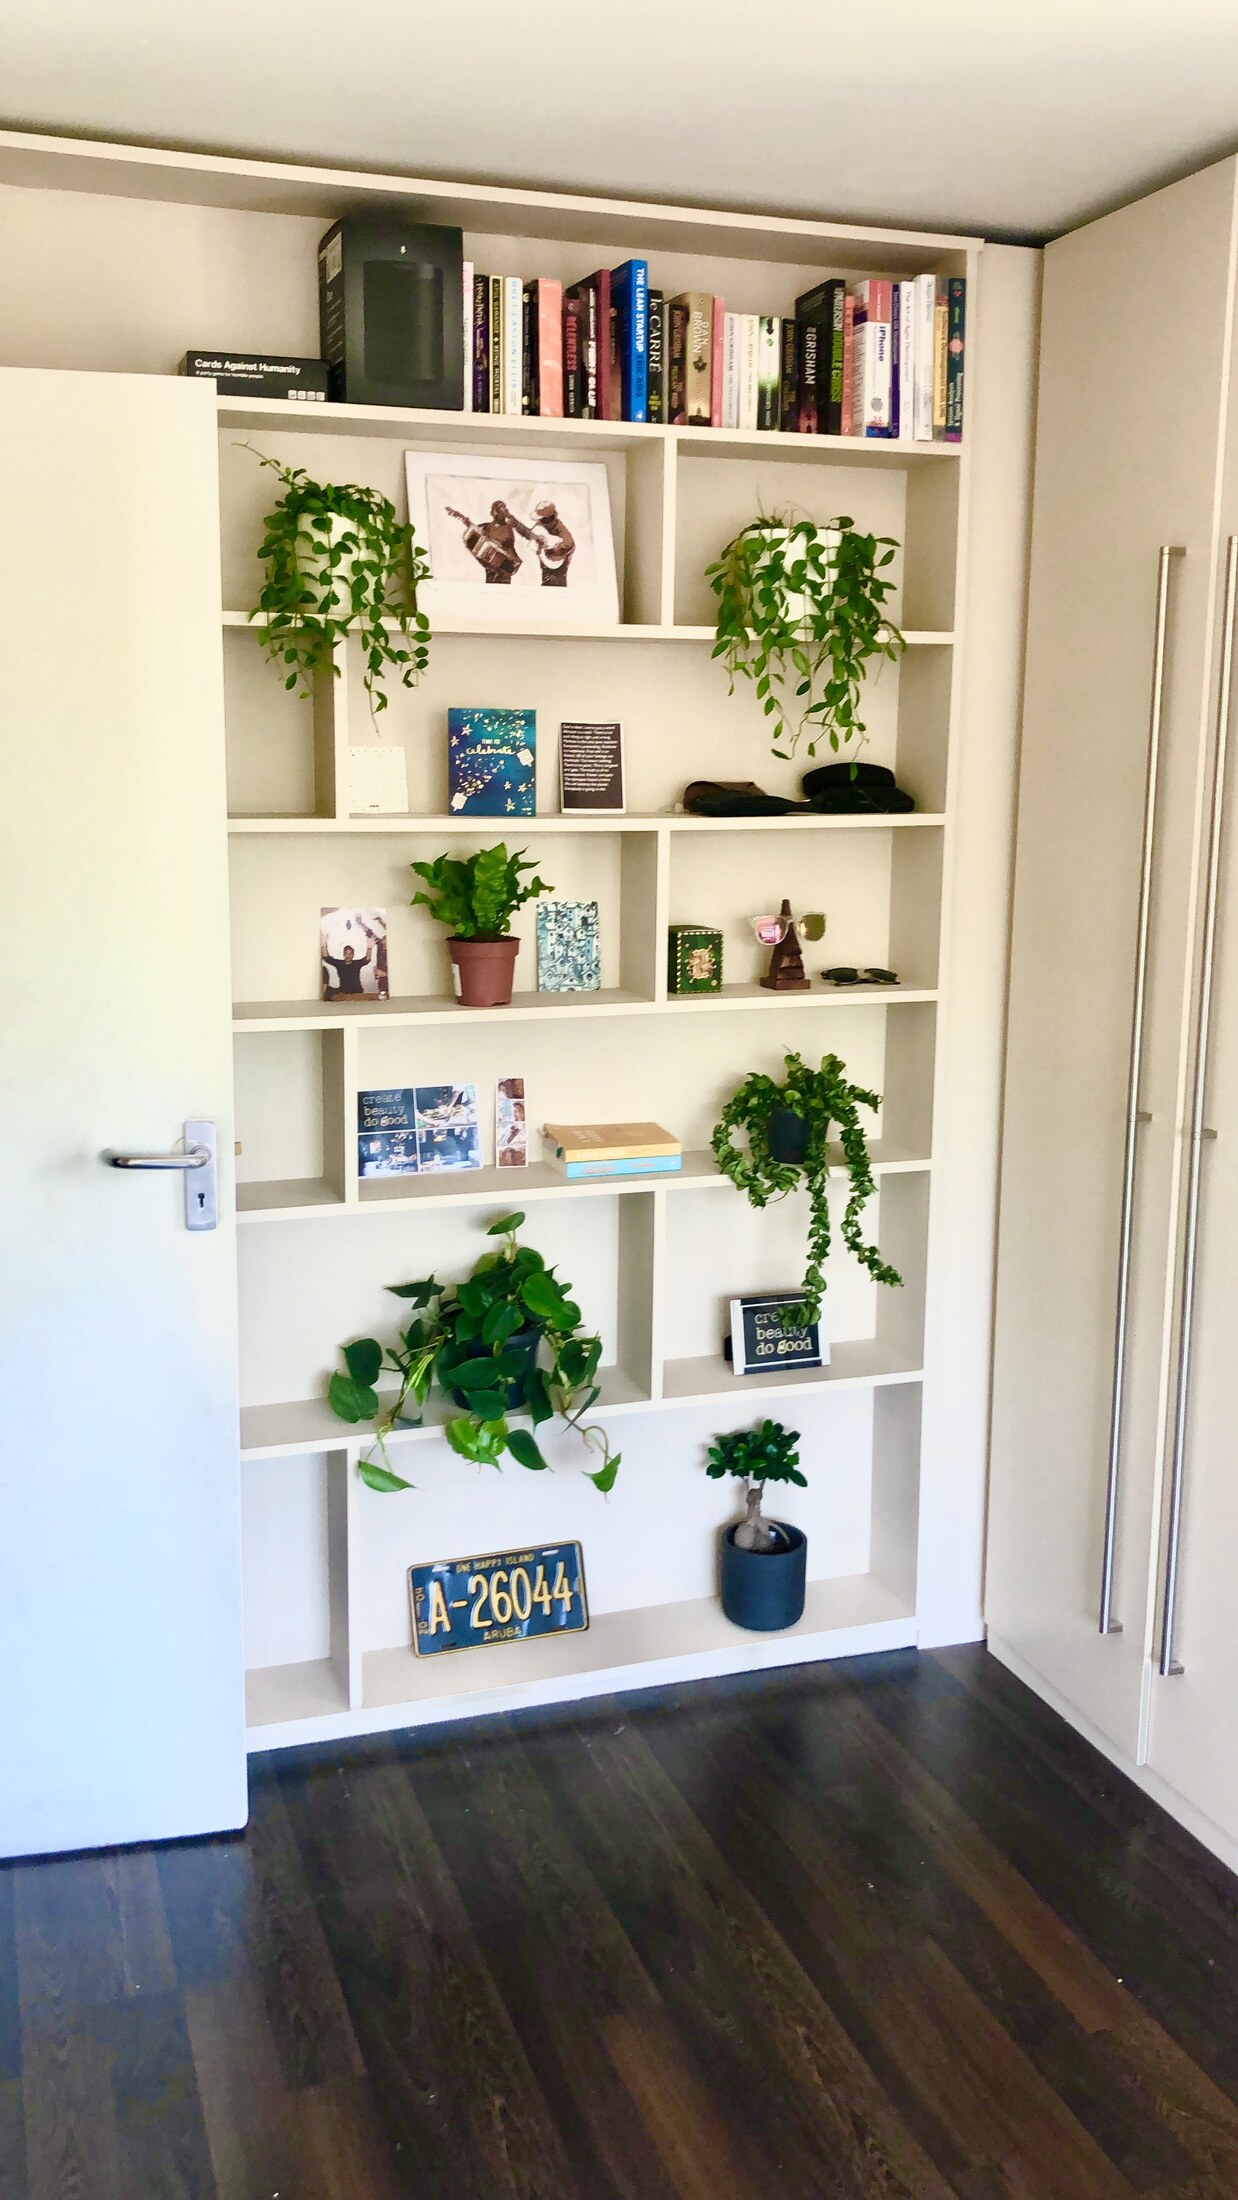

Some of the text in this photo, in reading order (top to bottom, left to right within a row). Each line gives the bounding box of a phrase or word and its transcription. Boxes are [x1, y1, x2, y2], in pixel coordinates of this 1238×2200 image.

[636, 268, 645, 285] THE
[636, 288, 645, 311] LEAN
[649, 298, 662, 311] le
[566, 316, 578, 371] RELENTLESS
[636, 313, 645, 353] STARTUP
[692, 311, 703, 353] BROWN
[702, 320, 710, 345] DAN
[878, 325, 887, 362] iPhone
[805, 333, 817, 385] GRISHAM
[832, 331, 843, 369] DOUBLE
[194, 358, 302, 376] Cards Against Humanity
[588, 376, 597, 407] CLUB
[831, 370, 842, 403] CROSS
[466, 744, 516, 755] celebrate
[362, 1093, 402, 1105] create
[364, 1105, 406, 1116] beauty
[364, 1114, 408, 1127] do good
[756, 1337, 813, 1356] do good
[456, 1552, 534, 1574] ONE HAPPY ISLAND
[430, 1560, 574, 1636] A-26044
[483, 1625, 522, 1641] ARUBA
